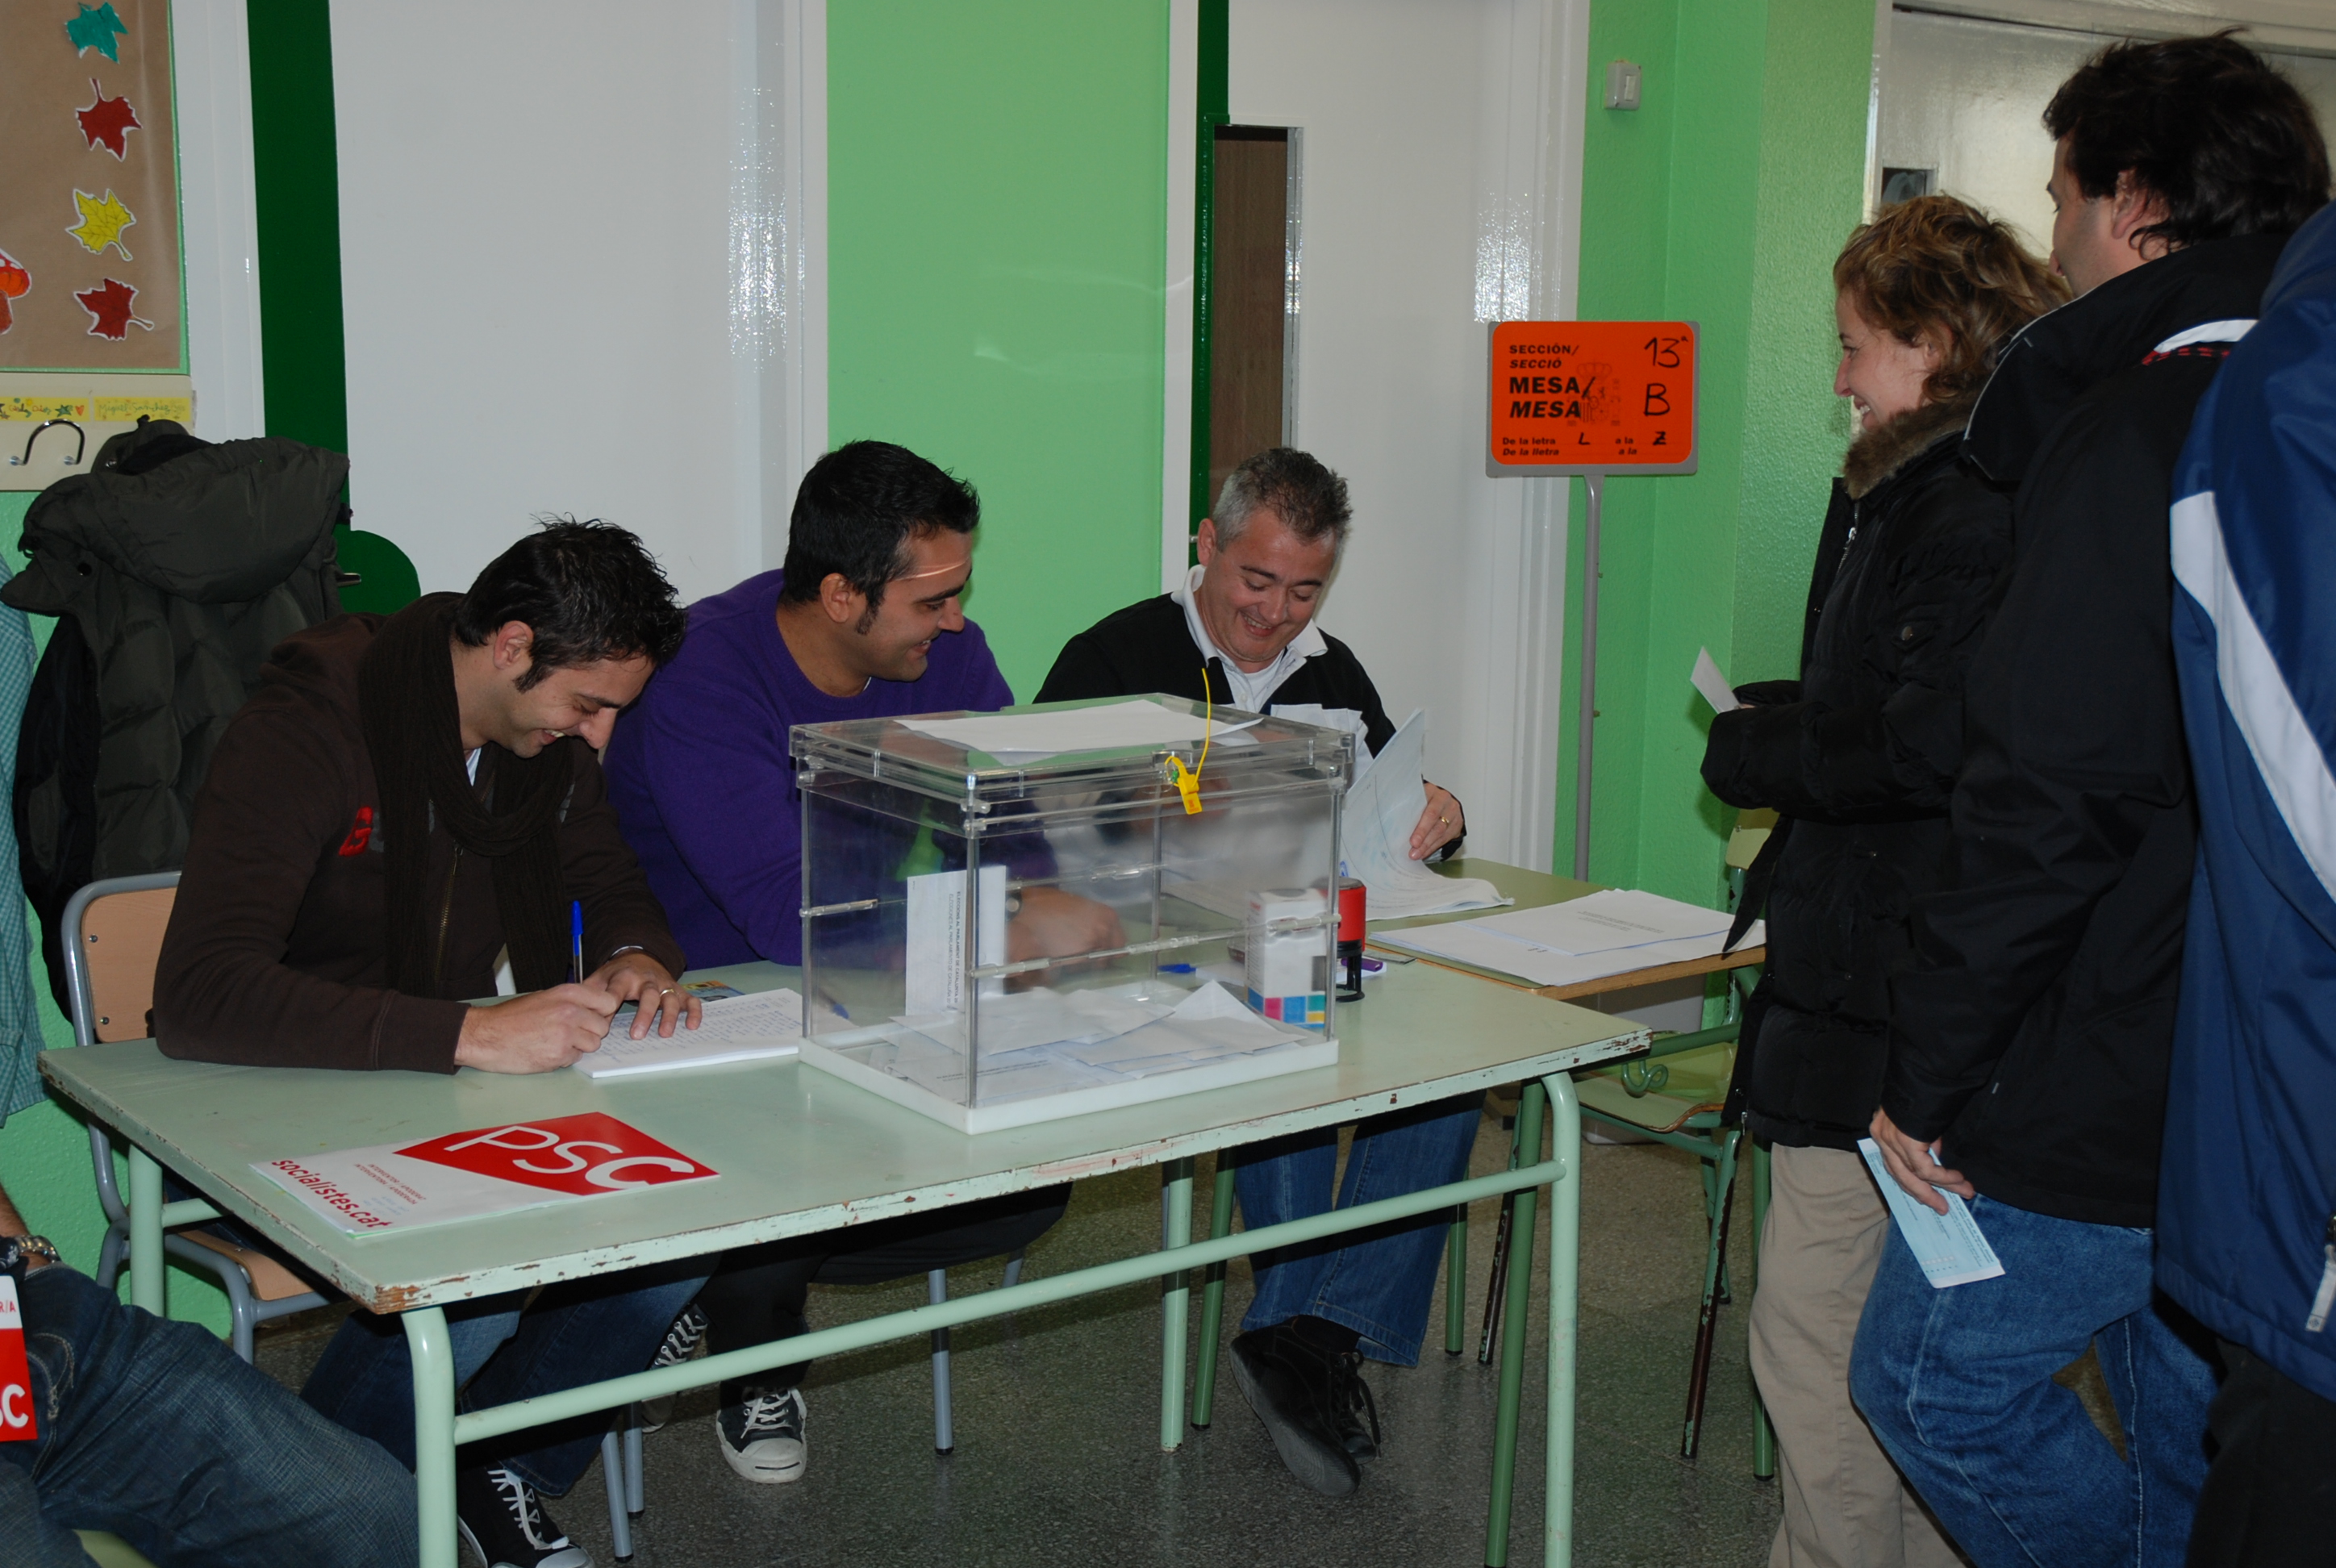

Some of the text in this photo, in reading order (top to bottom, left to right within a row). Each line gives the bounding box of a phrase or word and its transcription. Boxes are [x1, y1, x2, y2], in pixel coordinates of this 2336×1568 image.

[1510, 357, 1562, 369] SECCIÓ
[1509, 376, 1596, 398] MESA/
[1509, 401, 1582, 419] MESA
[1644, 382, 1671, 416] B
[1502, 437, 1516, 445] De
[1520, 437, 1529, 445] la
[1533, 437, 1556, 445] letra
[1578, 432, 1591, 445] L
[1625, 436, 1633, 444] la
[1653, 431, 1666, 446] Z
[1503, 448, 1516, 456] De
[1520, 448, 1529, 456] la
[1532, 448, 1559, 456] lletra
[1628, 447, 1637, 455] la
[444, 1126, 695, 1190] PSC
[272, 1160, 394, 1228] socialistes.cat
[0, 1383, 29, 1429] C
